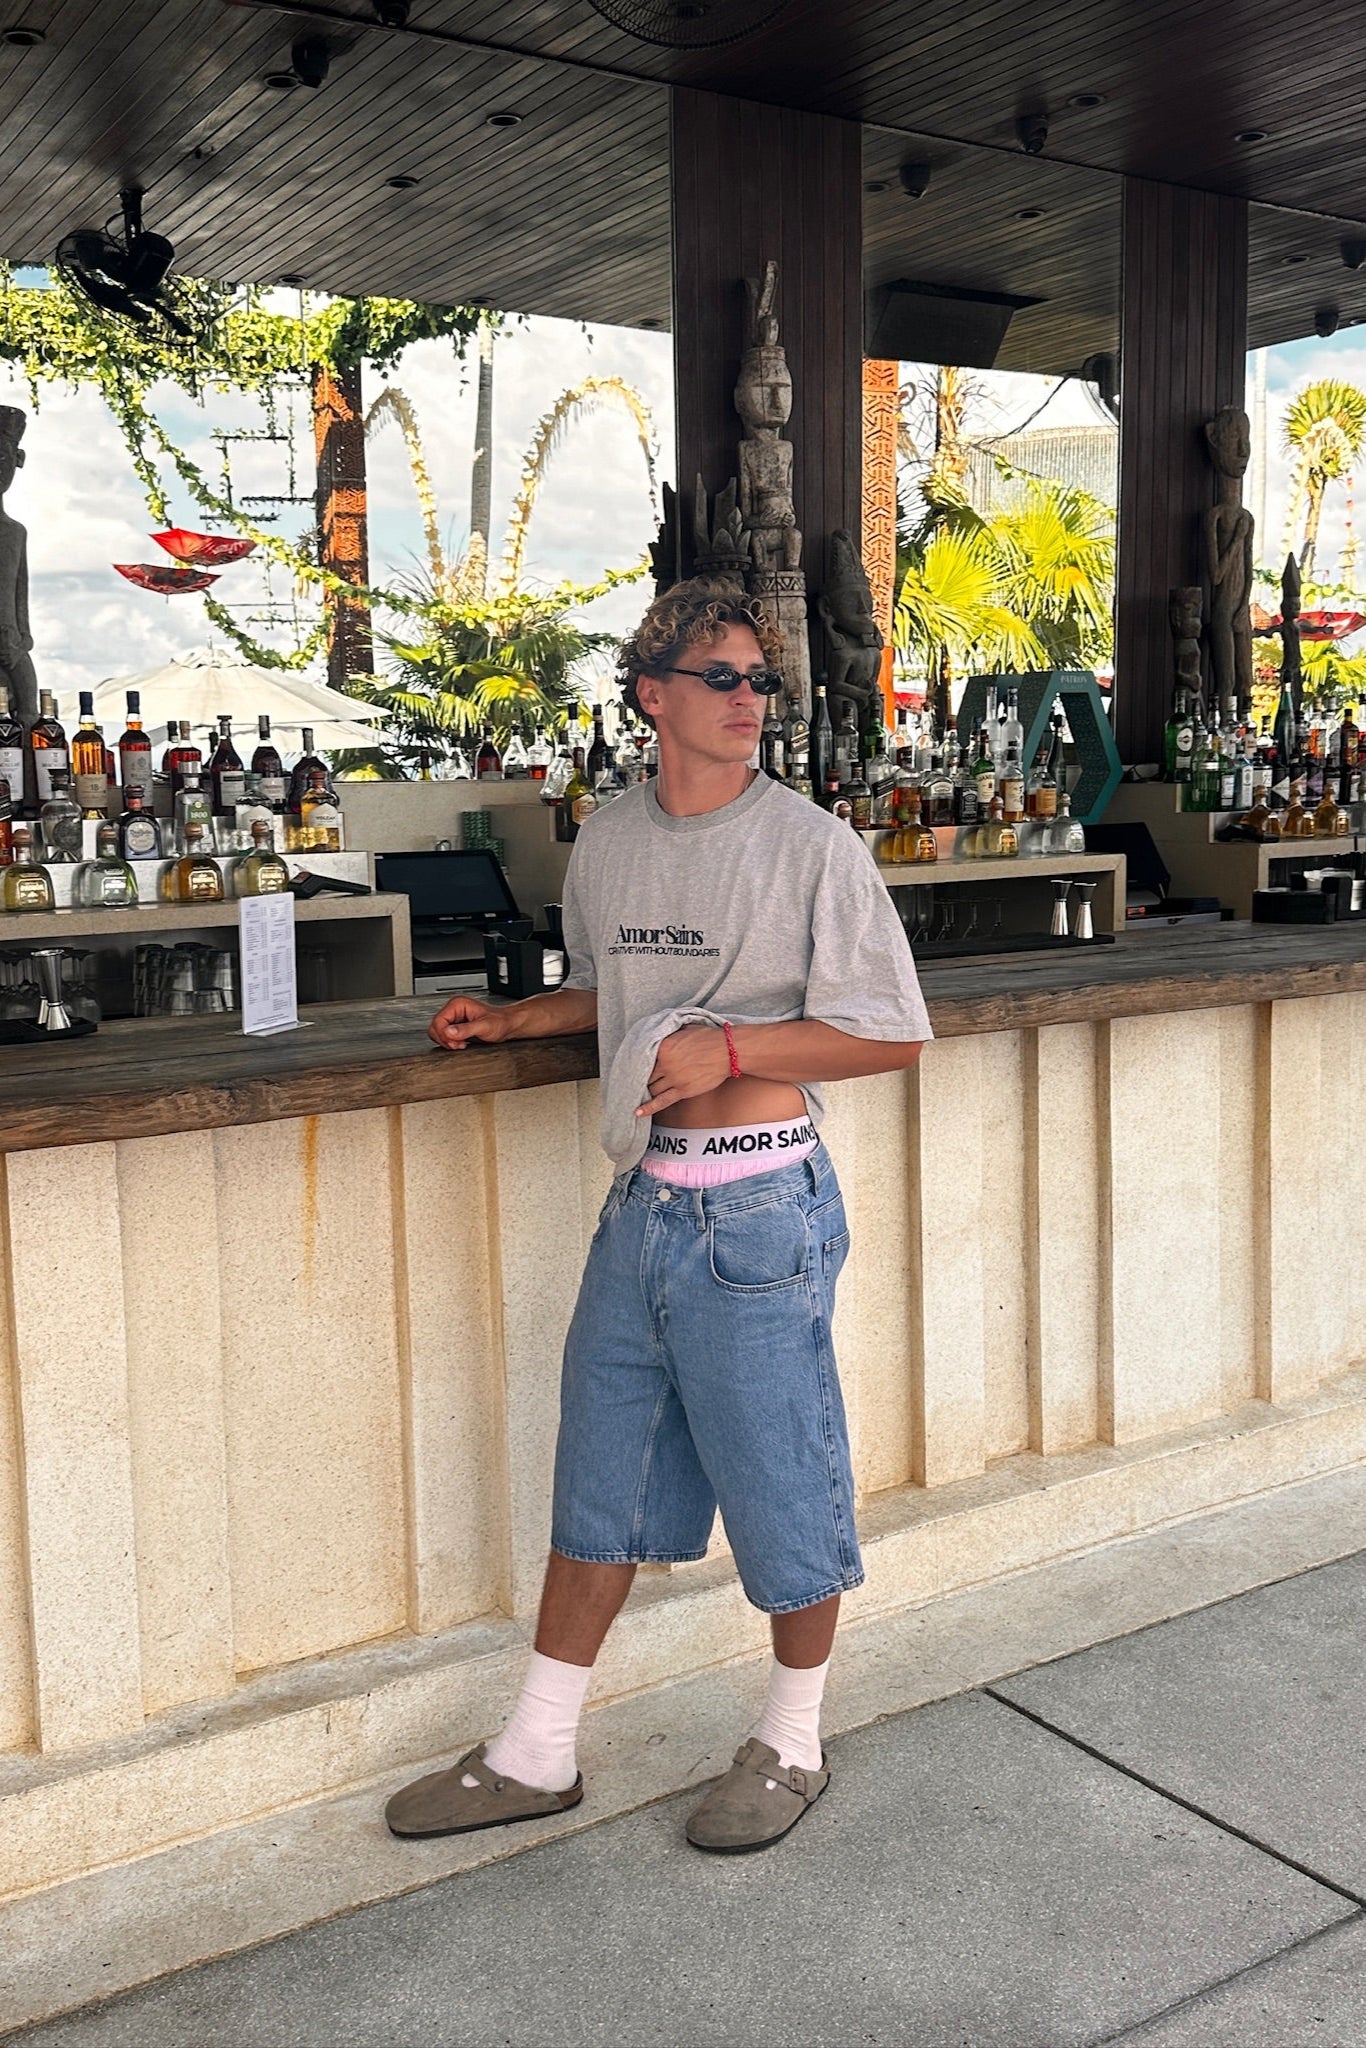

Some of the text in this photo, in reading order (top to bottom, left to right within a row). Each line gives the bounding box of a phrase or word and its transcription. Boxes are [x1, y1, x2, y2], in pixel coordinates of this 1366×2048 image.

[615, 924, 704, 945] Amor Sains
[635, 946, 672, 956] WITHOUT
[703, 1132, 773, 1155] AMOR
